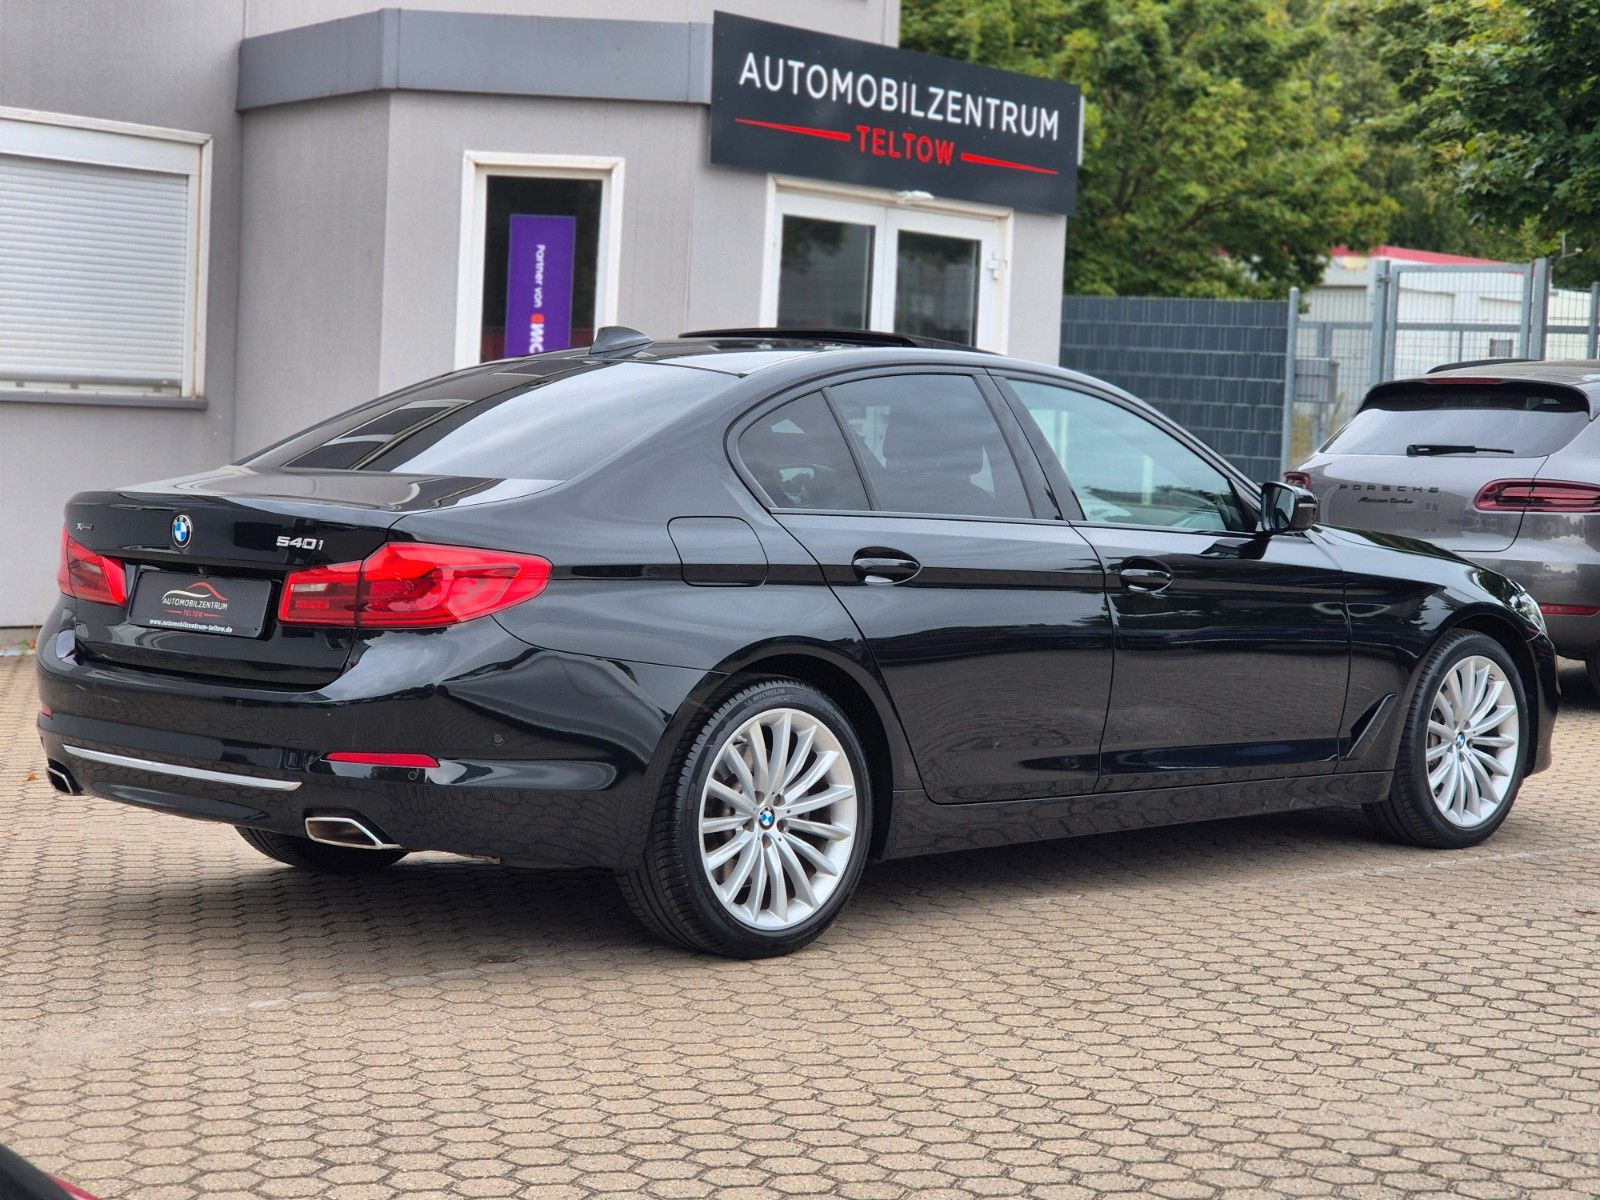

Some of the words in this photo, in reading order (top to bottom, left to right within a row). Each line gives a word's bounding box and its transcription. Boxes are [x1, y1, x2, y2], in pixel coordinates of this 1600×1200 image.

[739, 52, 1059, 141] AUTOMOBILZENTRUM
[856, 125, 955, 166] TELTOW
[534, 244, 546, 285] Partner
[533, 286, 543, 309] von
[1339, 484, 1440, 494] PORSCHE
[276, 535, 324, 551] 540i
[162, 597, 229, 611] AUTOMOBILZENTRUM
[183, 609, 204, 618] TELTOW
[149, 619, 233, 633] www.automobilzentrum-teltow.de
